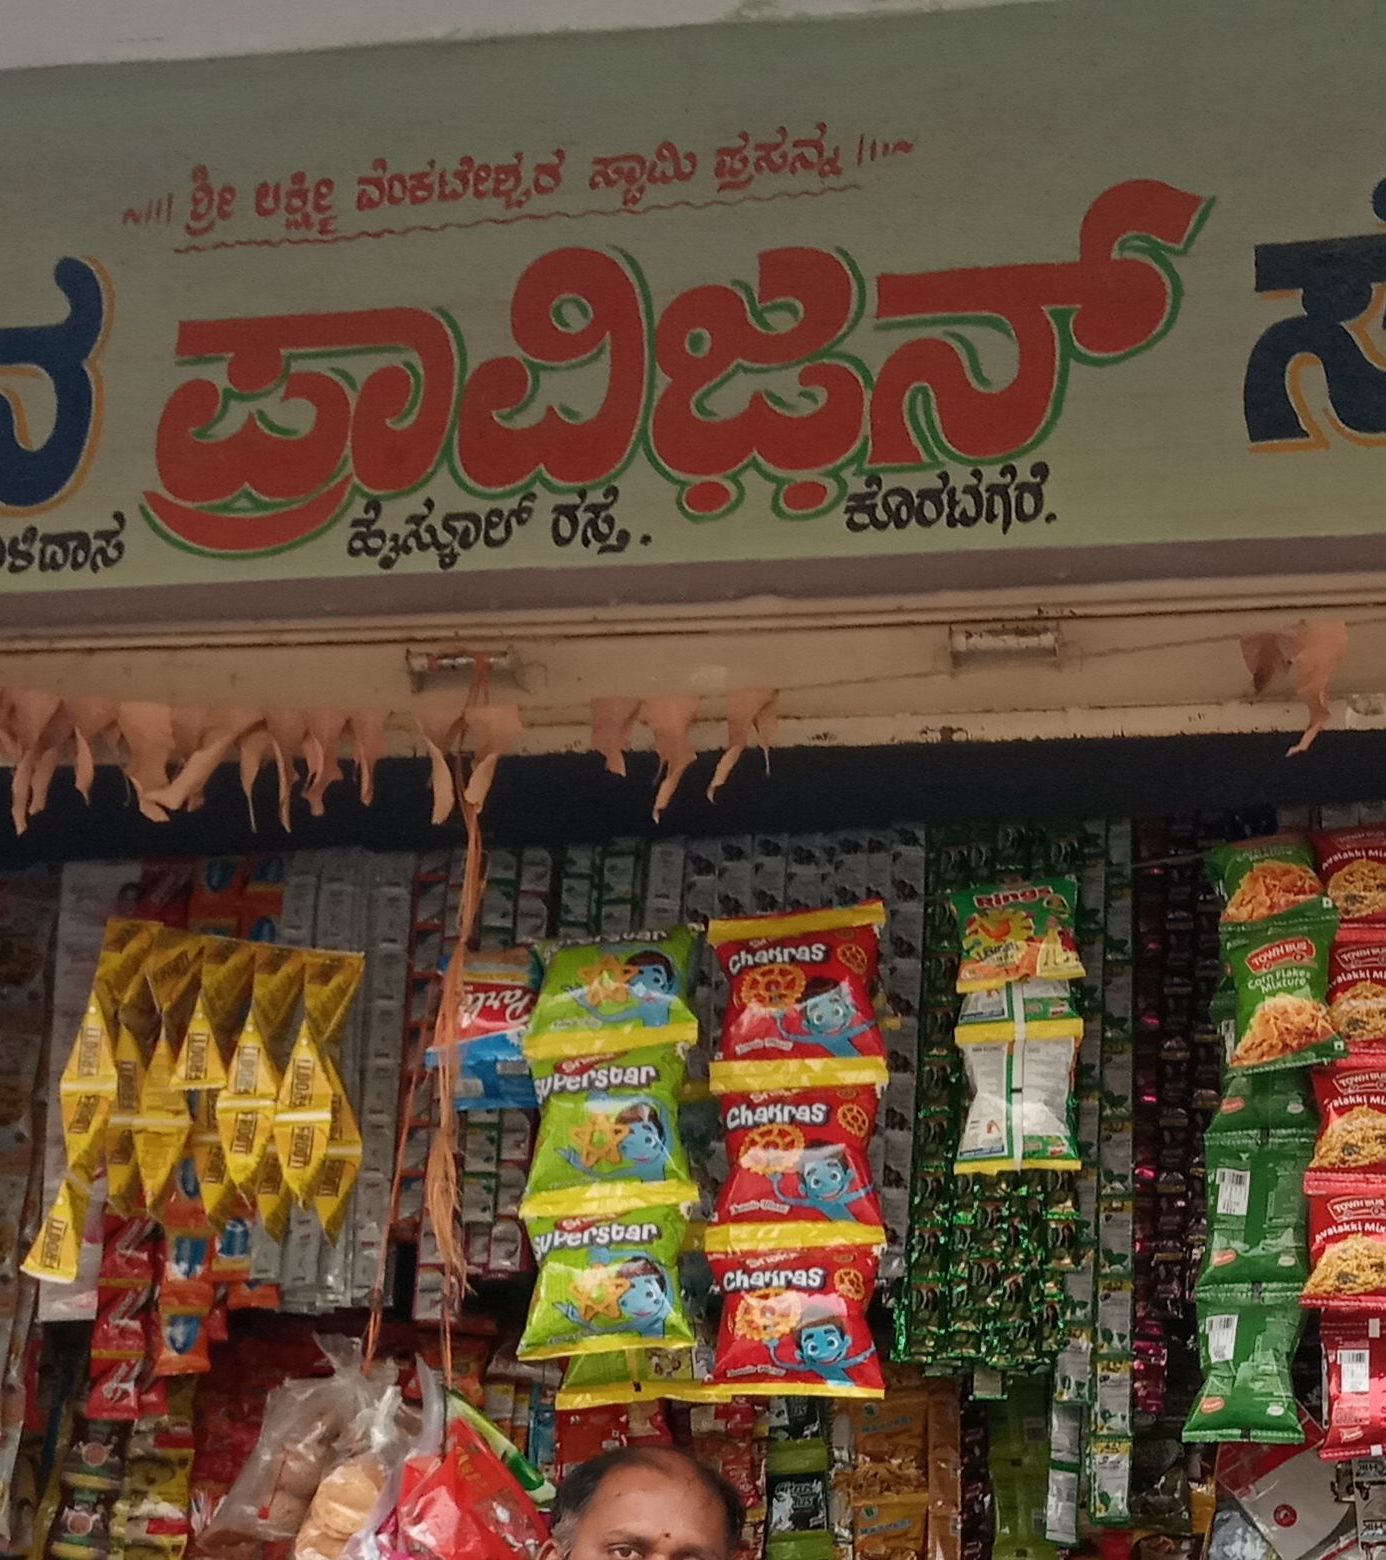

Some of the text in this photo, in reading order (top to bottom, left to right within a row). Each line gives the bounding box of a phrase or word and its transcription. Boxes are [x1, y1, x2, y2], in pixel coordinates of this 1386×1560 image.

[185, 164, 237, 237] ಶ್ರೀ
[590, 141, 698, 207] ಸ್ವಾಮಿ
[715, 122, 844, 193] ಪ್ರಸನ್ನ
[347, 489, 535, 571] ಹೈಸ್ಕೂಲ್
[727, 943, 827, 976] Chakras
[1251, 945, 1284, 967] TOWN
[187, 1031, 210, 1081] FROOTI
[291, 1057, 316, 1108] FROOTI
[725, 1101, 827, 1131] Chakras
[288, 1125, 315, 1170] FROOTI
[722, 1265, 826, 1293] Chakras
